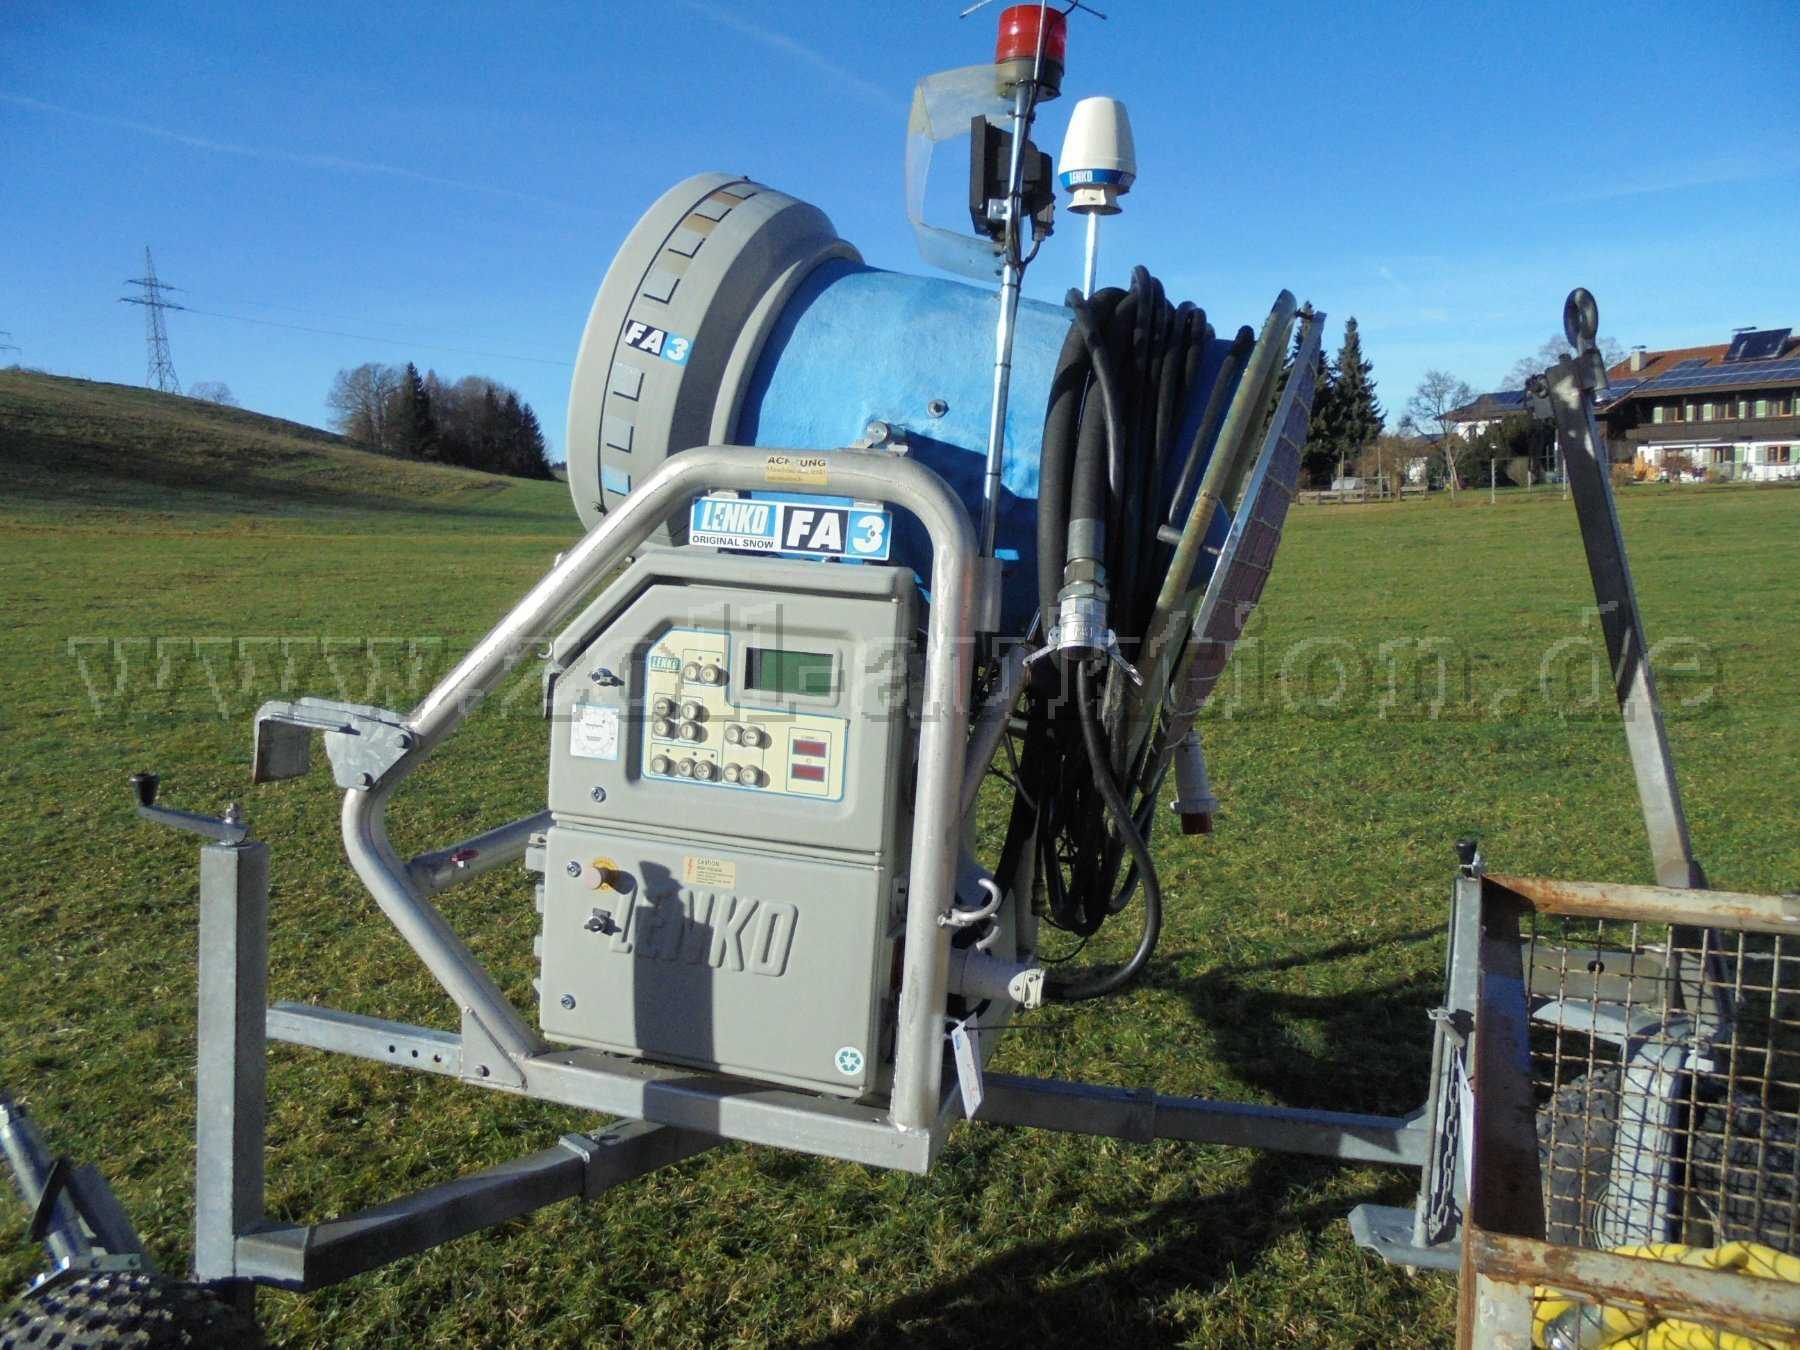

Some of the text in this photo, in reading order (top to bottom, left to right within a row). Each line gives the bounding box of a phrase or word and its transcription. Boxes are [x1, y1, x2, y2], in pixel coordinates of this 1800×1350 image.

[1069, 169, 1093, 185] LENKO
[768, 456, 826, 467] ACUNG
[701, 501, 770, 535] LENKO
[692, 534, 774, 549] ORIGINAL SNOW
